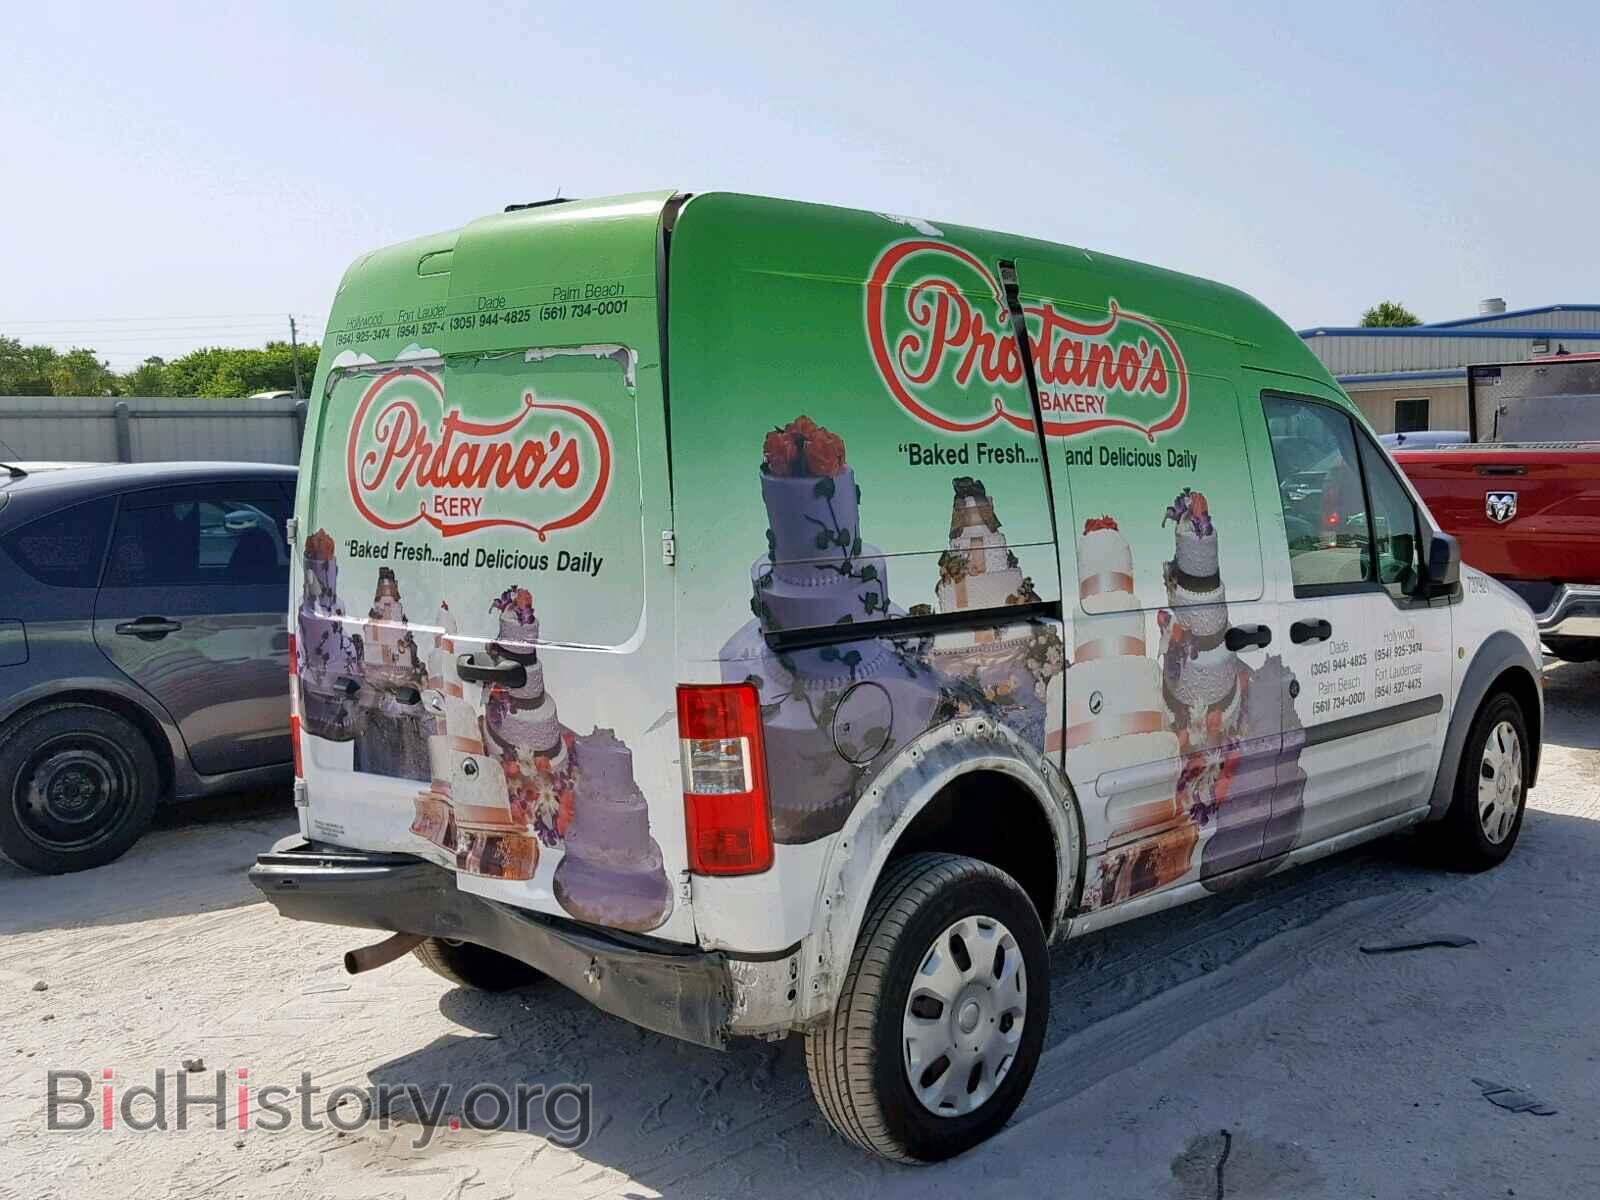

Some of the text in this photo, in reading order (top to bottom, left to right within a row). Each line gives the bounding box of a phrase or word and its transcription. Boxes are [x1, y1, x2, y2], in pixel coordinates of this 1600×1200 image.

[553, 281, 624, 301] Palm Beach
[478, 296, 506, 310] Dade
[540, 300, 628, 322] (561) 734-0001
[397, 323, 419, 340] (954)
[450, 309, 531, 332] (305) 944-4825
[898, 279, 1168, 394] Protano's
[1039, 391, 1105, 415] BAKERY
[976, 442, 1039, 464] Fresh...
[1066, 446, 1093, 466] and
[1099, 446, 1162, 468] Delicious
[1167, 449, 1198, 473] Daily
[475, 548, 549, 571] Delicious
[556, 554, 603, 577] Daily
[1329, 640, 1350, 655] Dade
[1375, 642, 1423, 662] (954) 925-3474
[1311, 653, 1367, 676] (305) 944-4825
[1313, 691, 1366, 716] (561) 734-0001
